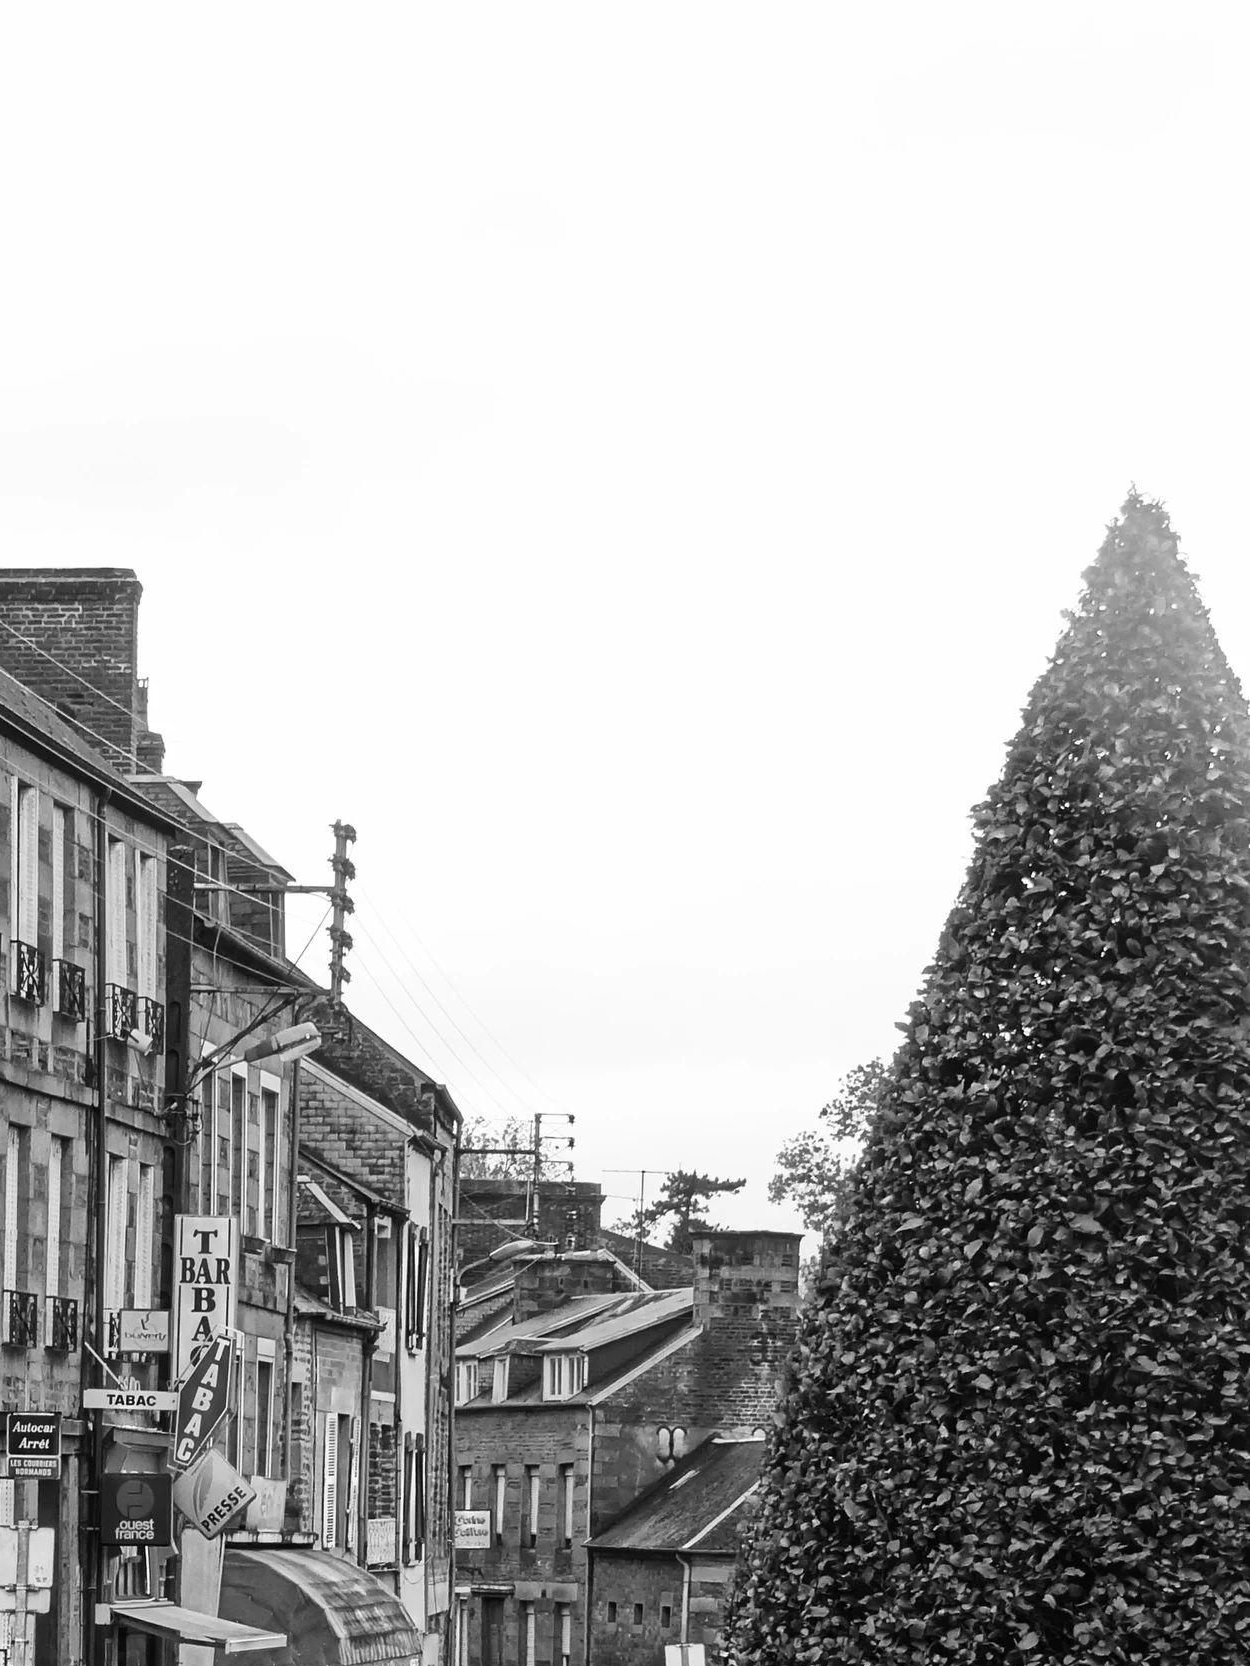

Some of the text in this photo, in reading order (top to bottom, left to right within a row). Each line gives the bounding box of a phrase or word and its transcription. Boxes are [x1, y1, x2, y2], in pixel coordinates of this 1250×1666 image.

[179, 1257, 231, 1285] BAR
[106, 1394, 157, 1407] TABAC
[176, 1337, 231, 1461] TABAC
[12, 1421, 56, 1433] Autocar
[10, 1459, 57, 1468] LES COURRIERS
[15, 1468, 52, 1476] NORMANDS
[201, 1486, 247, 1532] PRESSE
[119, 1518, 154, 1530] ouest
[115, 1527, 155, 1539] france
